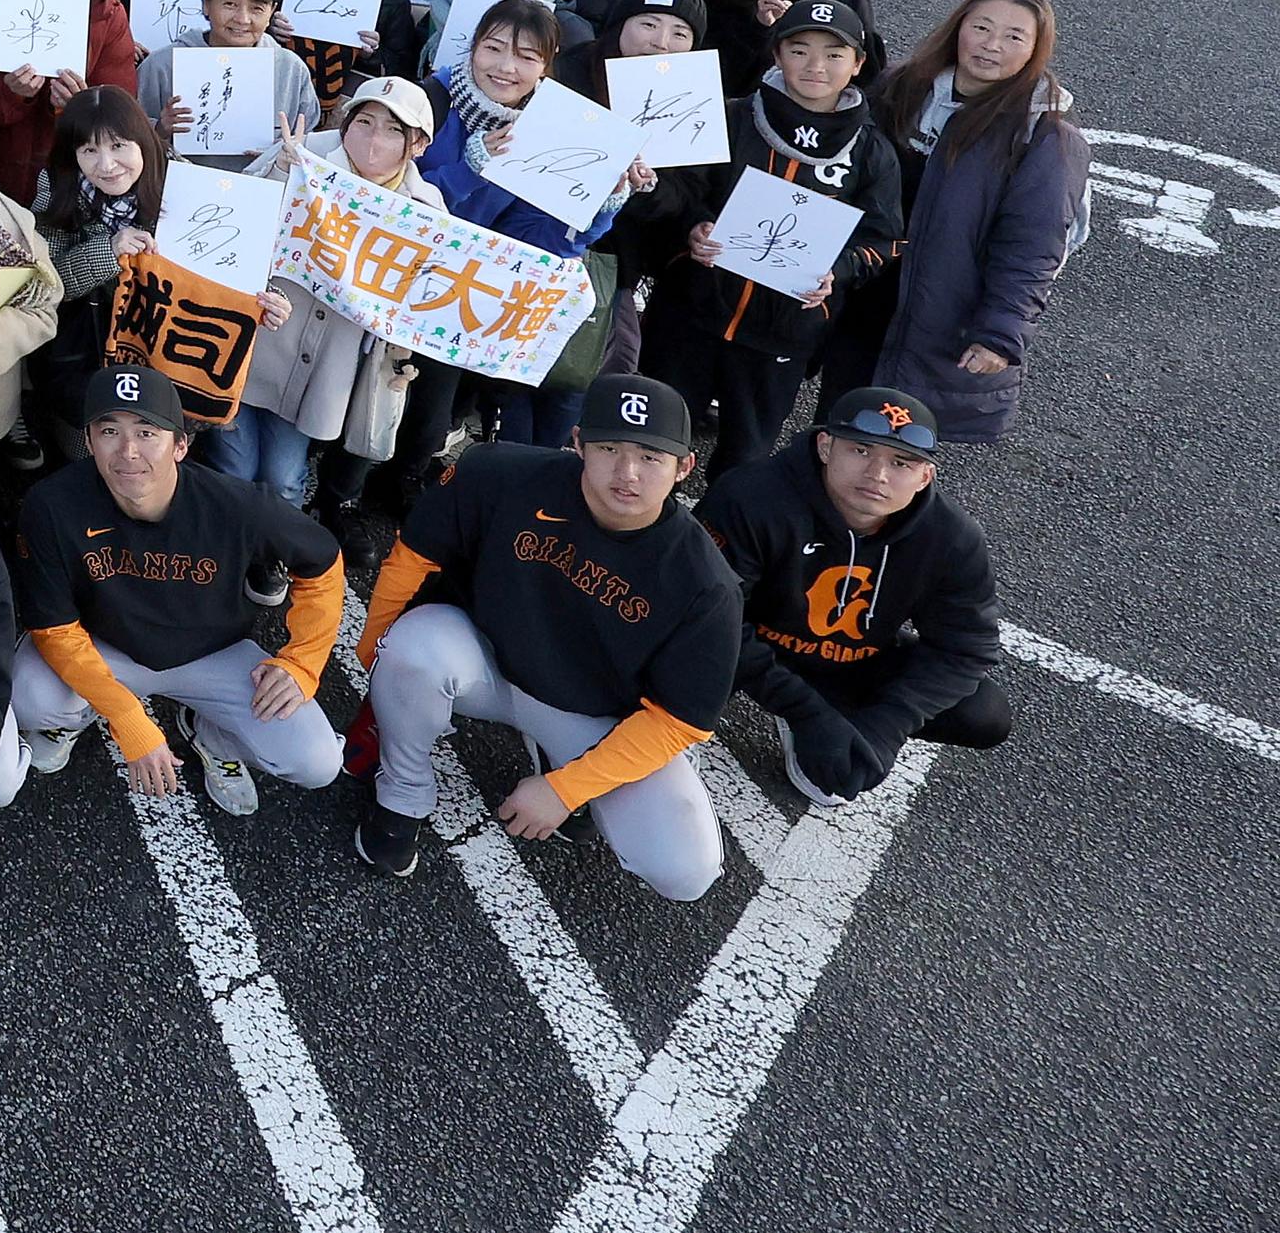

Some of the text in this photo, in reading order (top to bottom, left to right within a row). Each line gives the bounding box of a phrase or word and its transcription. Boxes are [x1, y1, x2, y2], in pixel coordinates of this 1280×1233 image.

[291, 195, 568, 342] 増田大輝
[82, 550, 218, 585] GIANTS
[513, 529, 650, 624] GIANTS
[808, 565, 874, 641] G
[756, 622, 879, 664] TOKYO GIANT
